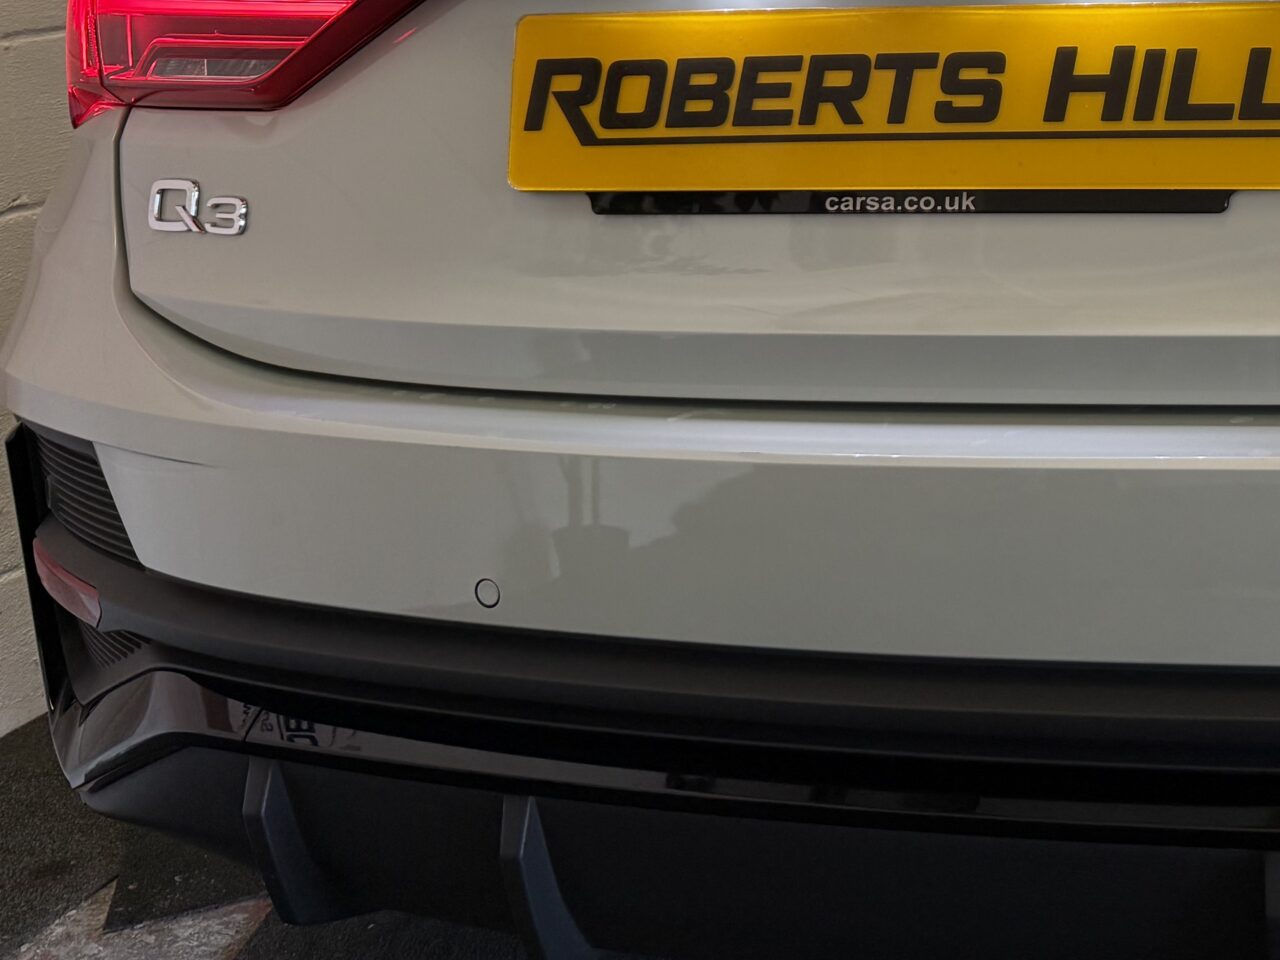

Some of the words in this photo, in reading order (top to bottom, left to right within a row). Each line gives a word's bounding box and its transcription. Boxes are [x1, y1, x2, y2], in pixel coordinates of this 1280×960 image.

[524, 50, 1007, 146] ROBERTS
[148, 178, 249, 236] Q3
[825, 192, 976, 211] carsa.co.uk
